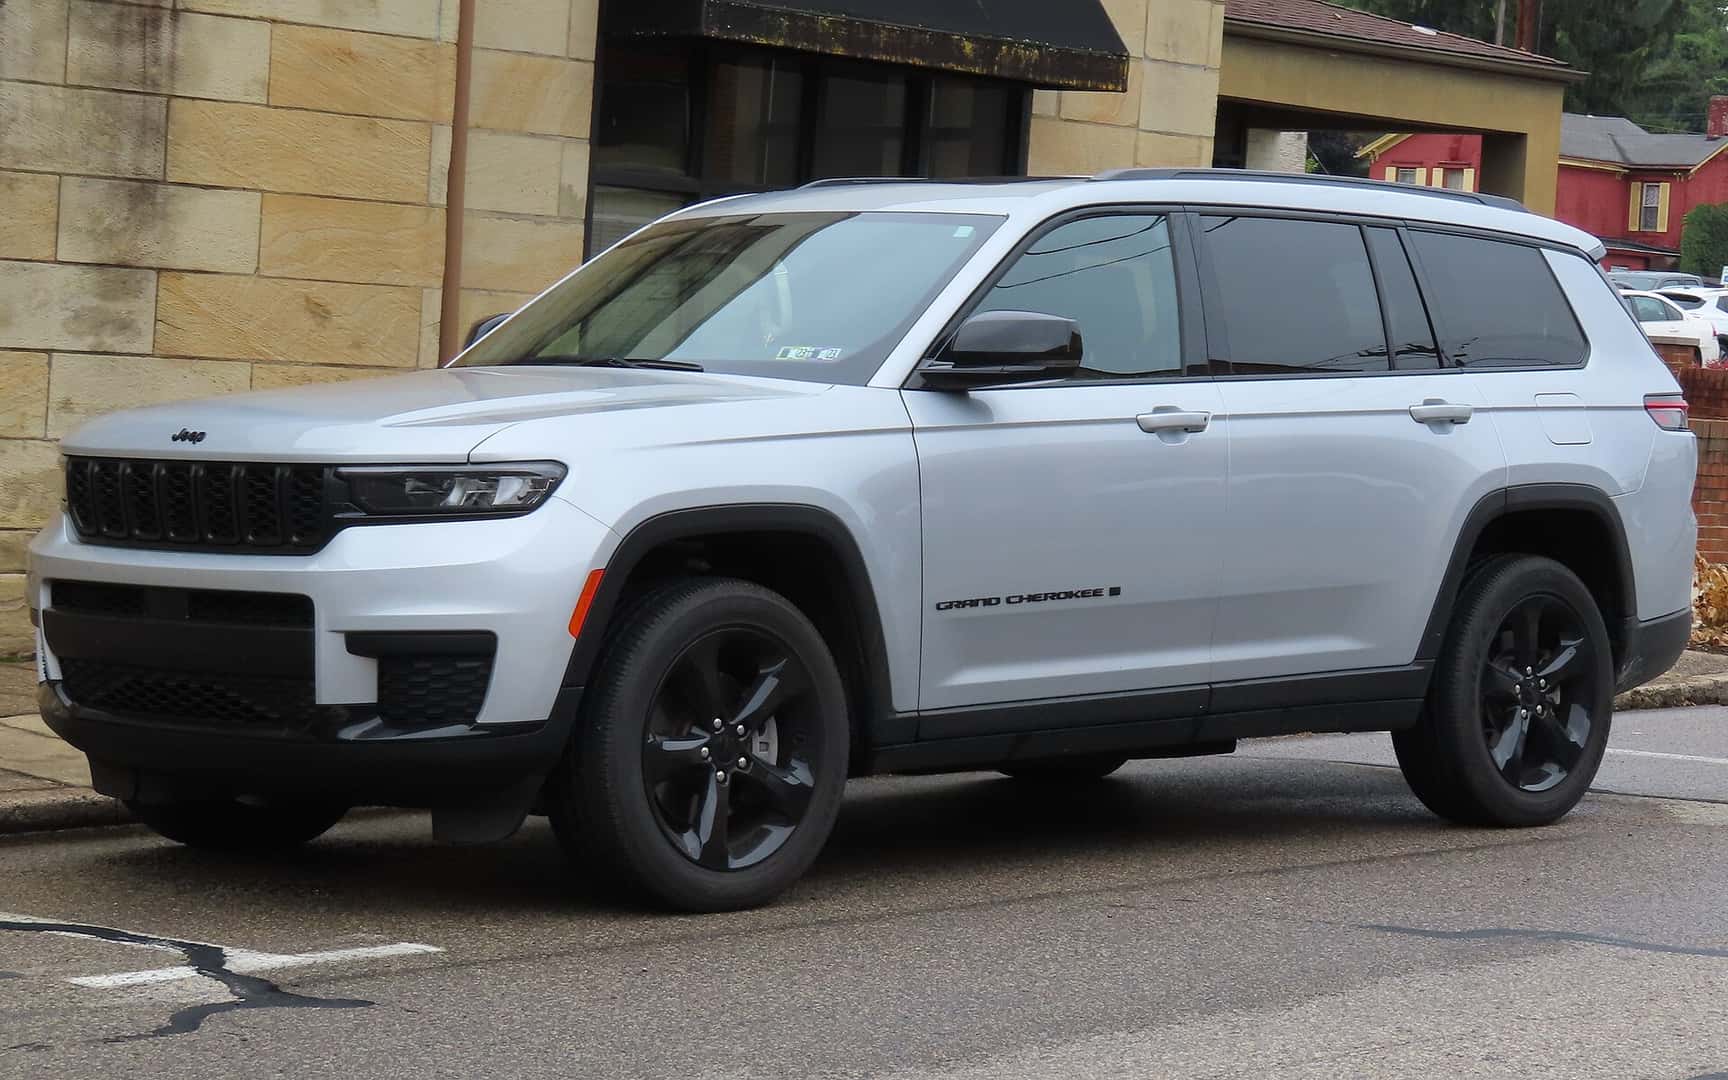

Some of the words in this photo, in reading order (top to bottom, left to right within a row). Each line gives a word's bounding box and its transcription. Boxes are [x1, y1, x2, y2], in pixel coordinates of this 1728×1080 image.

[171, 428, 206, 445] Jeep
[935, 597, 1001, 611] GRAND
[1005, 588, 1105, 605] CHEROKEE
